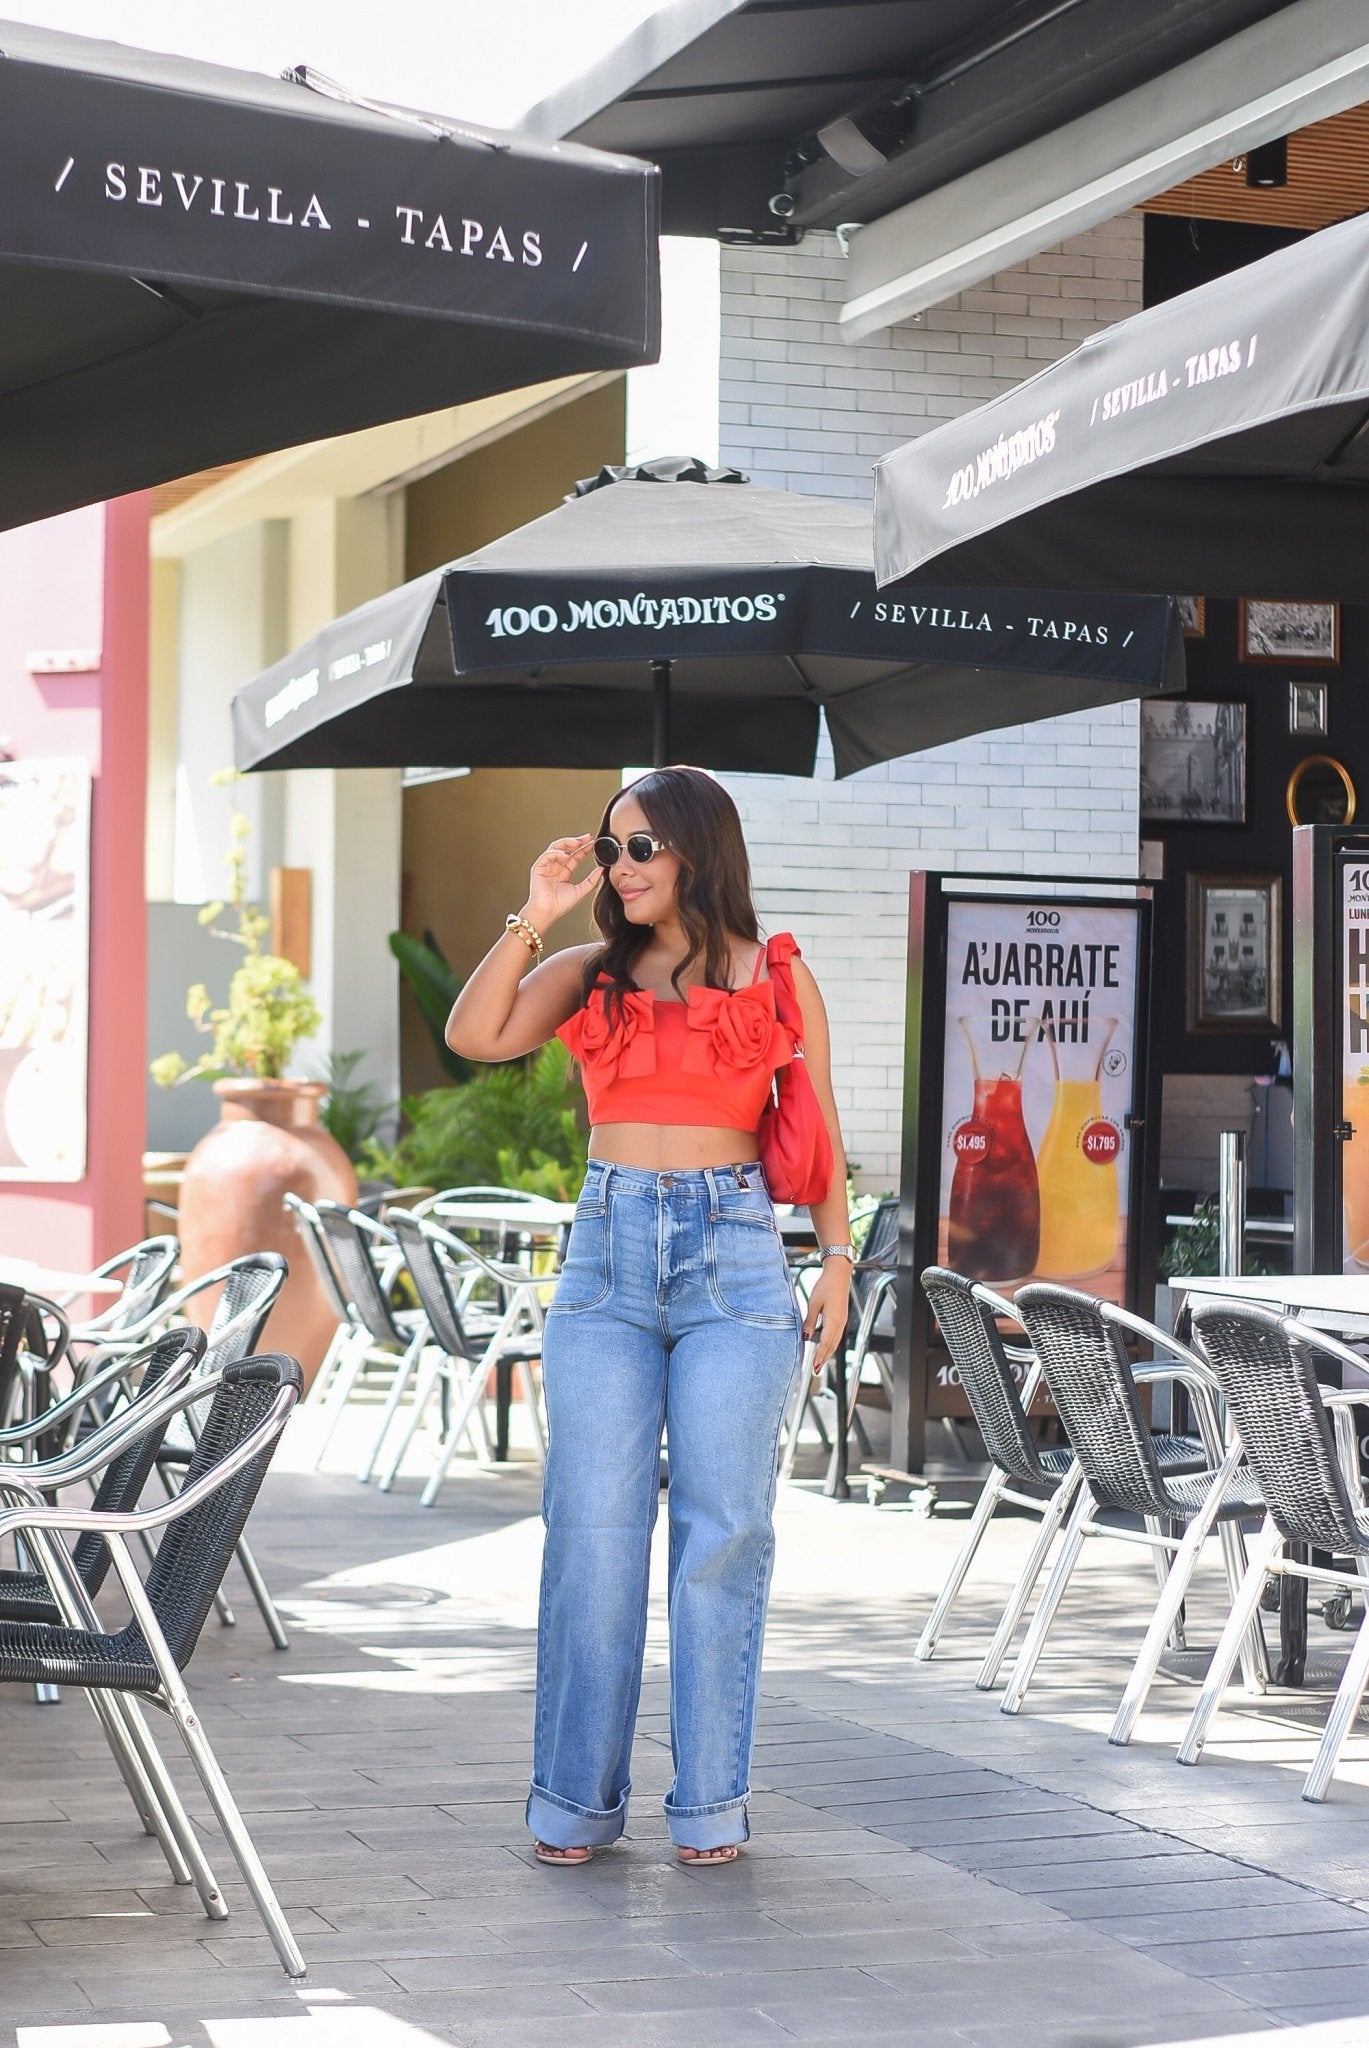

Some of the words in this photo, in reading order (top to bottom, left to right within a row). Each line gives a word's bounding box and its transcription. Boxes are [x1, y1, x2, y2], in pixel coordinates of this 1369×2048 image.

[104, 163, 331, 230] SEVILLA
[396, 205, 544, 267] TAPAS
[1101, 368, 1169, 421] SEVILLA
[1184, 339, 1242, 389] TAPAS
[485, 604, 559, 638] 100
[874, 602, 993, 632] SEVILLA
[1027, 617, 1109, 645] TAPAS
[1025, 910, 1061, 926] 100
[961, 941, 1120, 988] A'JARRATE
[991, 998, 1031, 1042] DE
[1037, 989, 1091, 1043] AHÍ
[957, 1134, 987, 1151] $1,495
